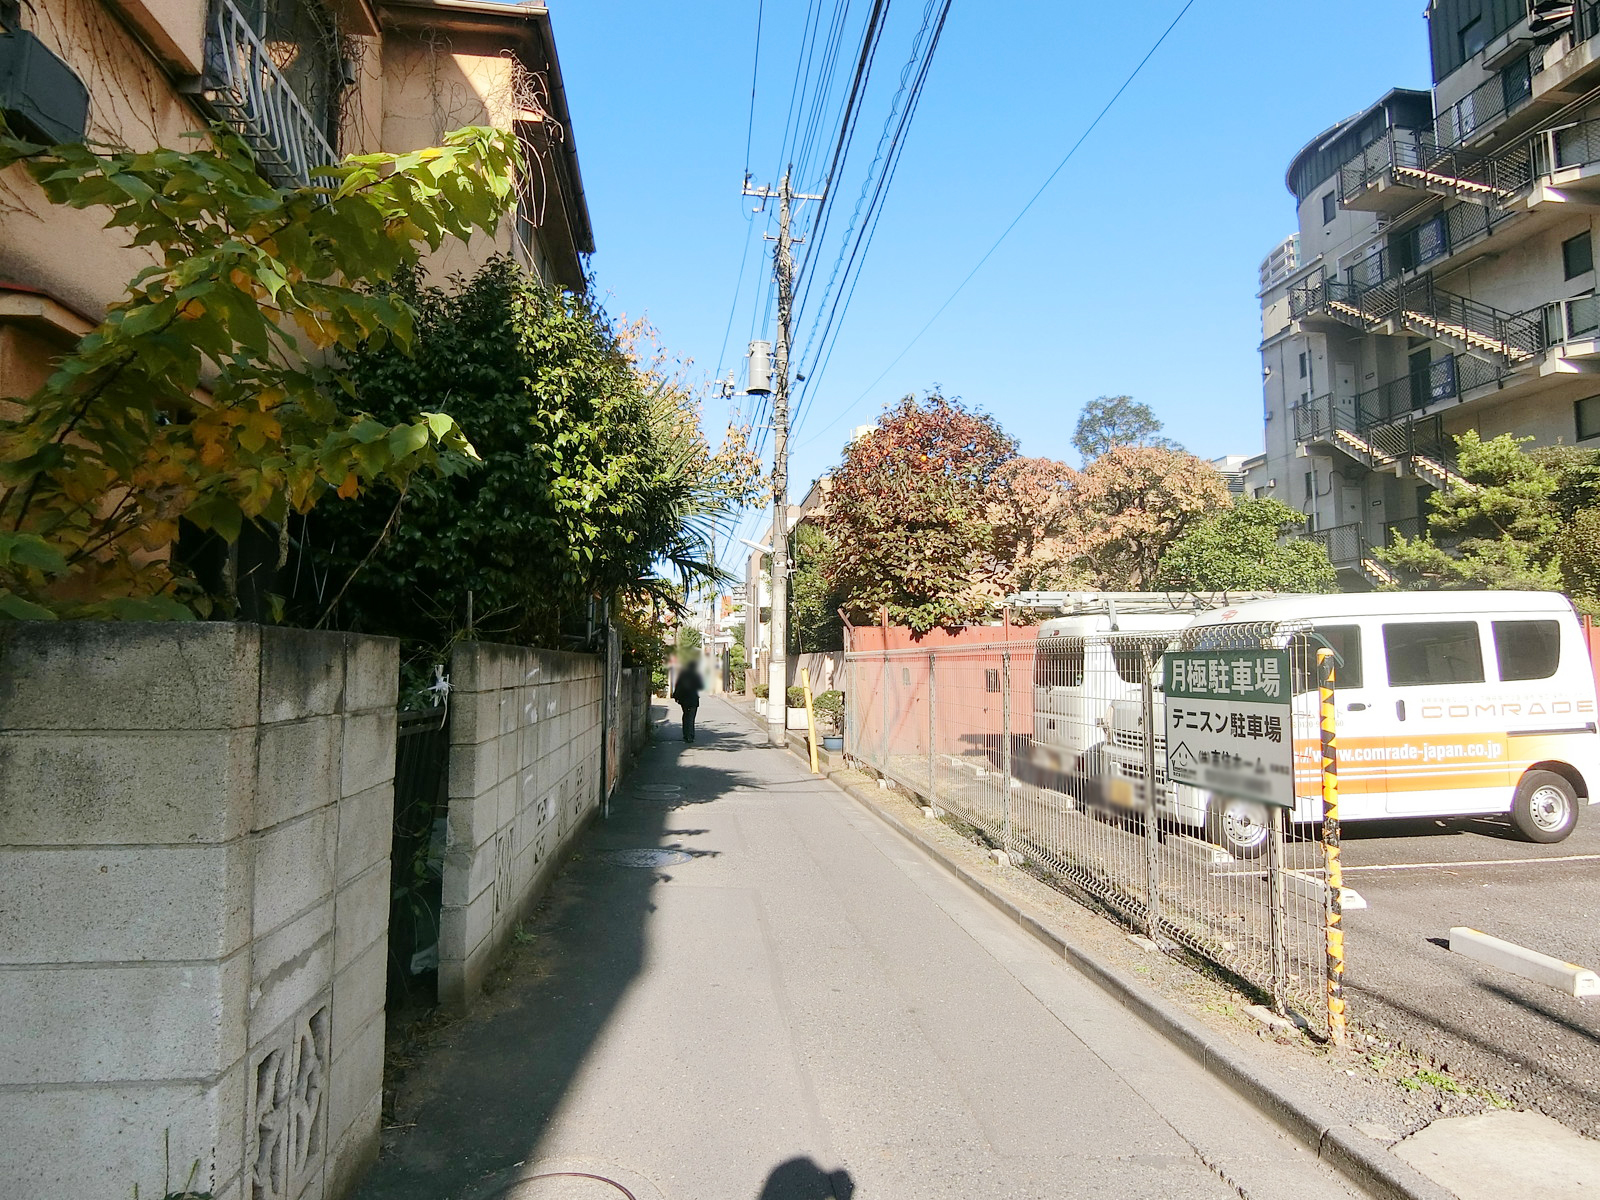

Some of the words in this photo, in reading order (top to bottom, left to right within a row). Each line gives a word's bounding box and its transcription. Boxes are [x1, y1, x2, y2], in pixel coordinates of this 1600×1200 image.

[1171, 657, 1281, 698] 月極駐車場
[1172, 708, 1282, 743] テニスン駐車場
[1421, 700, 1594, 719] COMRADE
